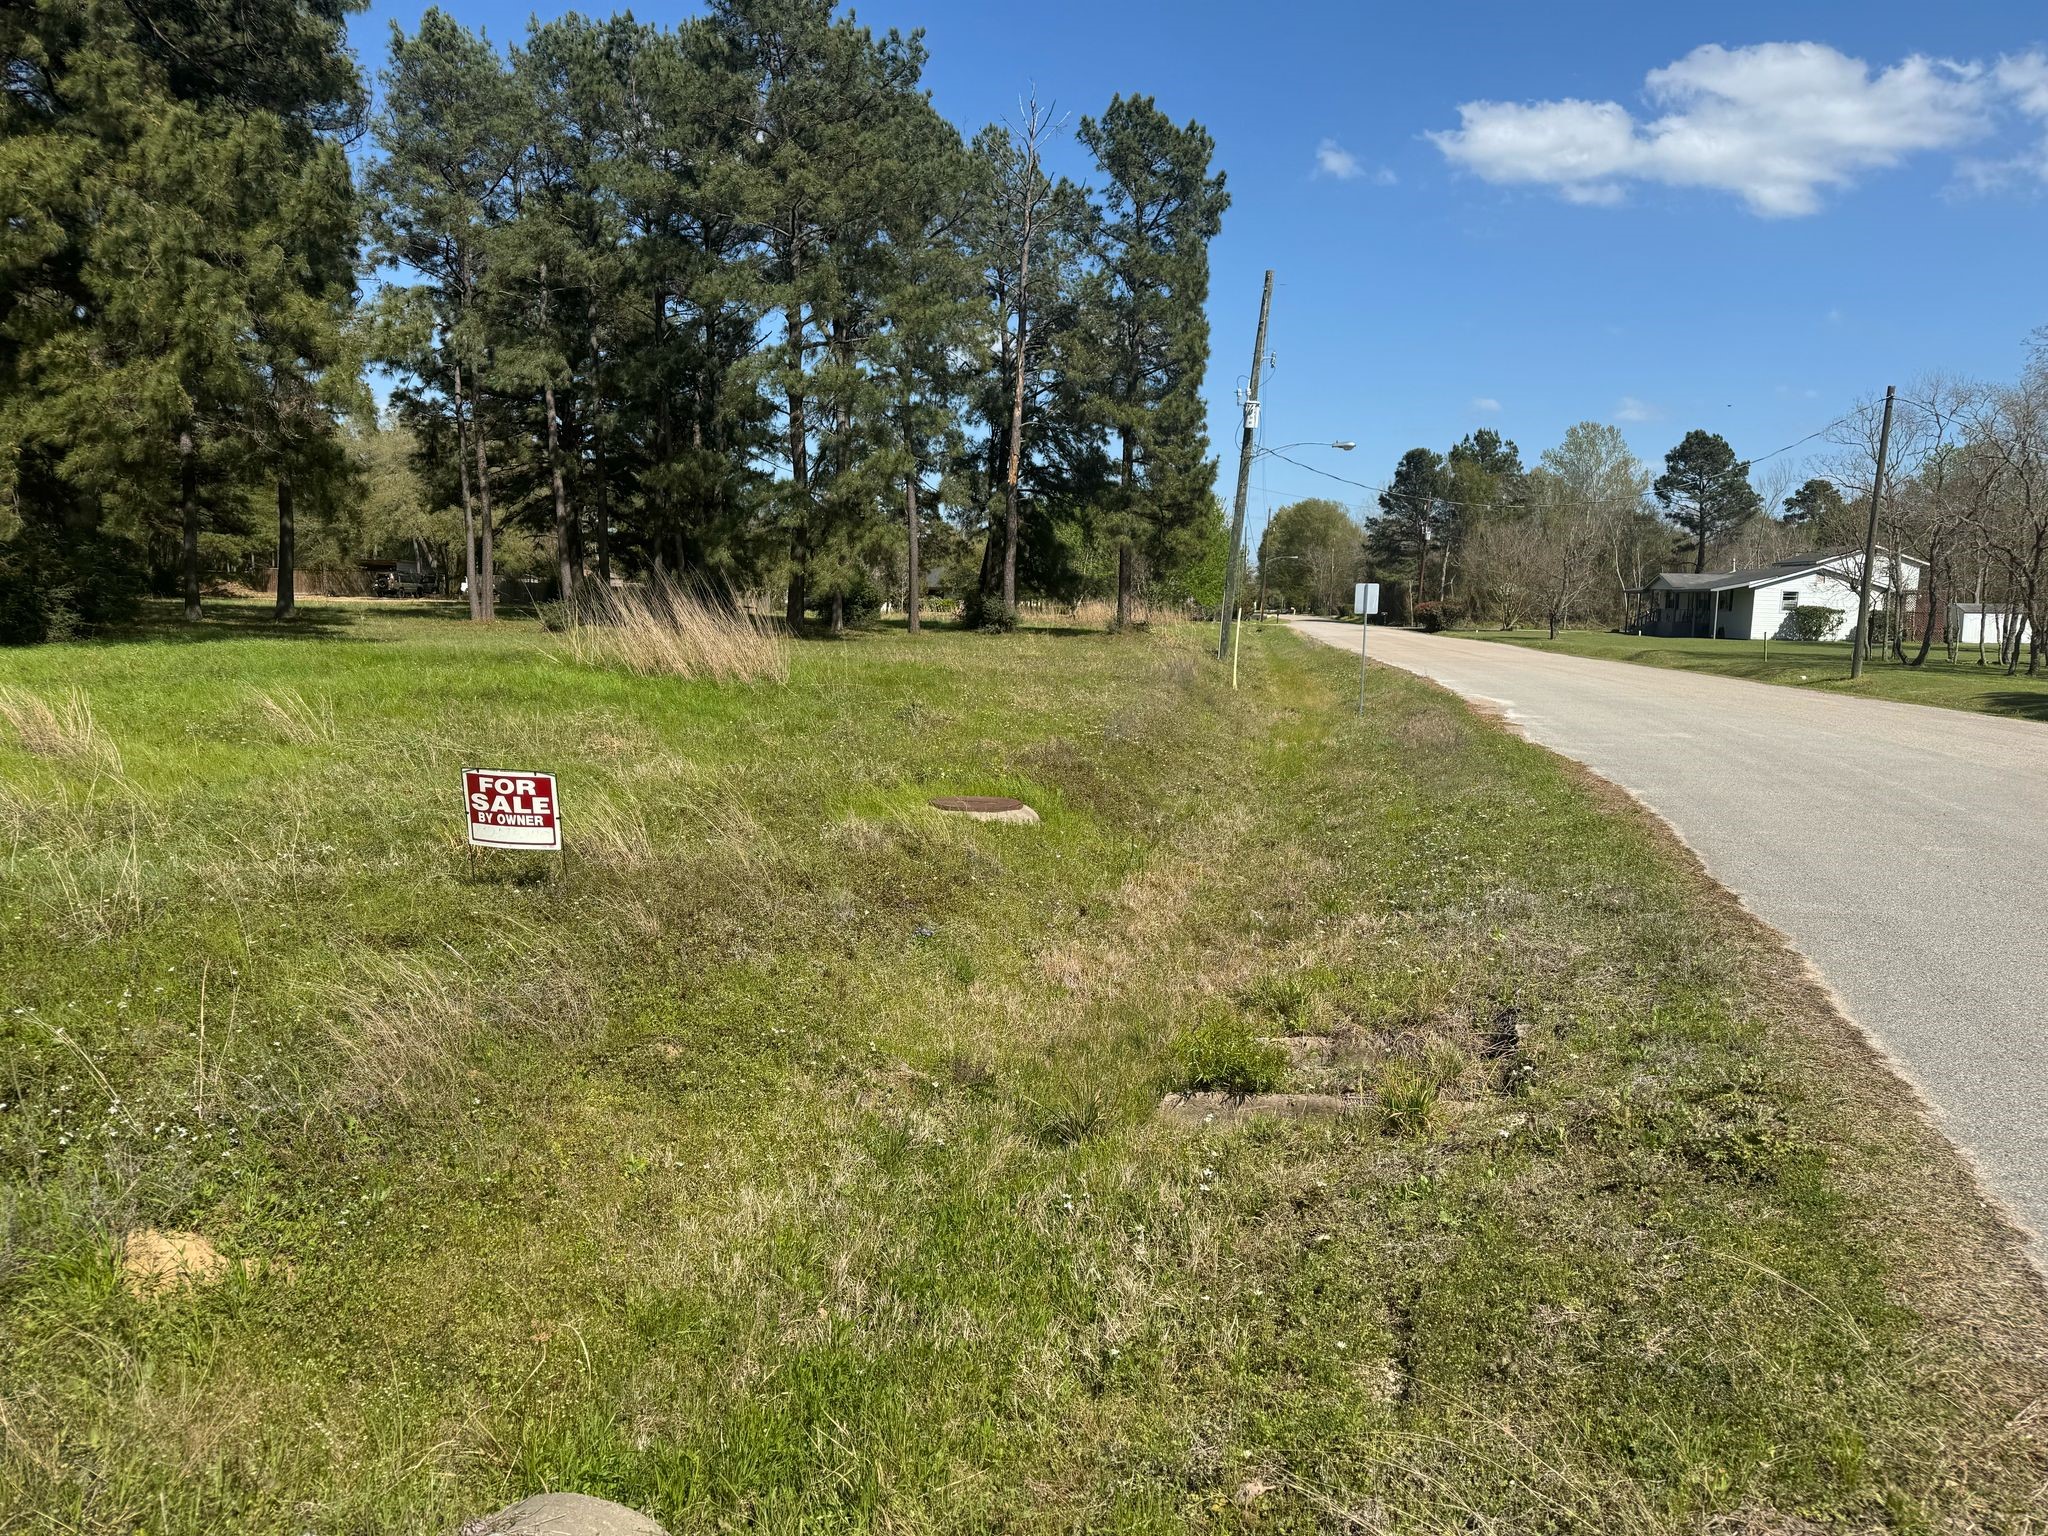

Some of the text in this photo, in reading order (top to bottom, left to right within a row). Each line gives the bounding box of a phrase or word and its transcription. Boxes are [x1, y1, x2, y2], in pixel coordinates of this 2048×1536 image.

[479, 777, 536, 795] FOR
[471, 793, 550, 814] SALE
[478, 812, 544, 826] BY OWNER
